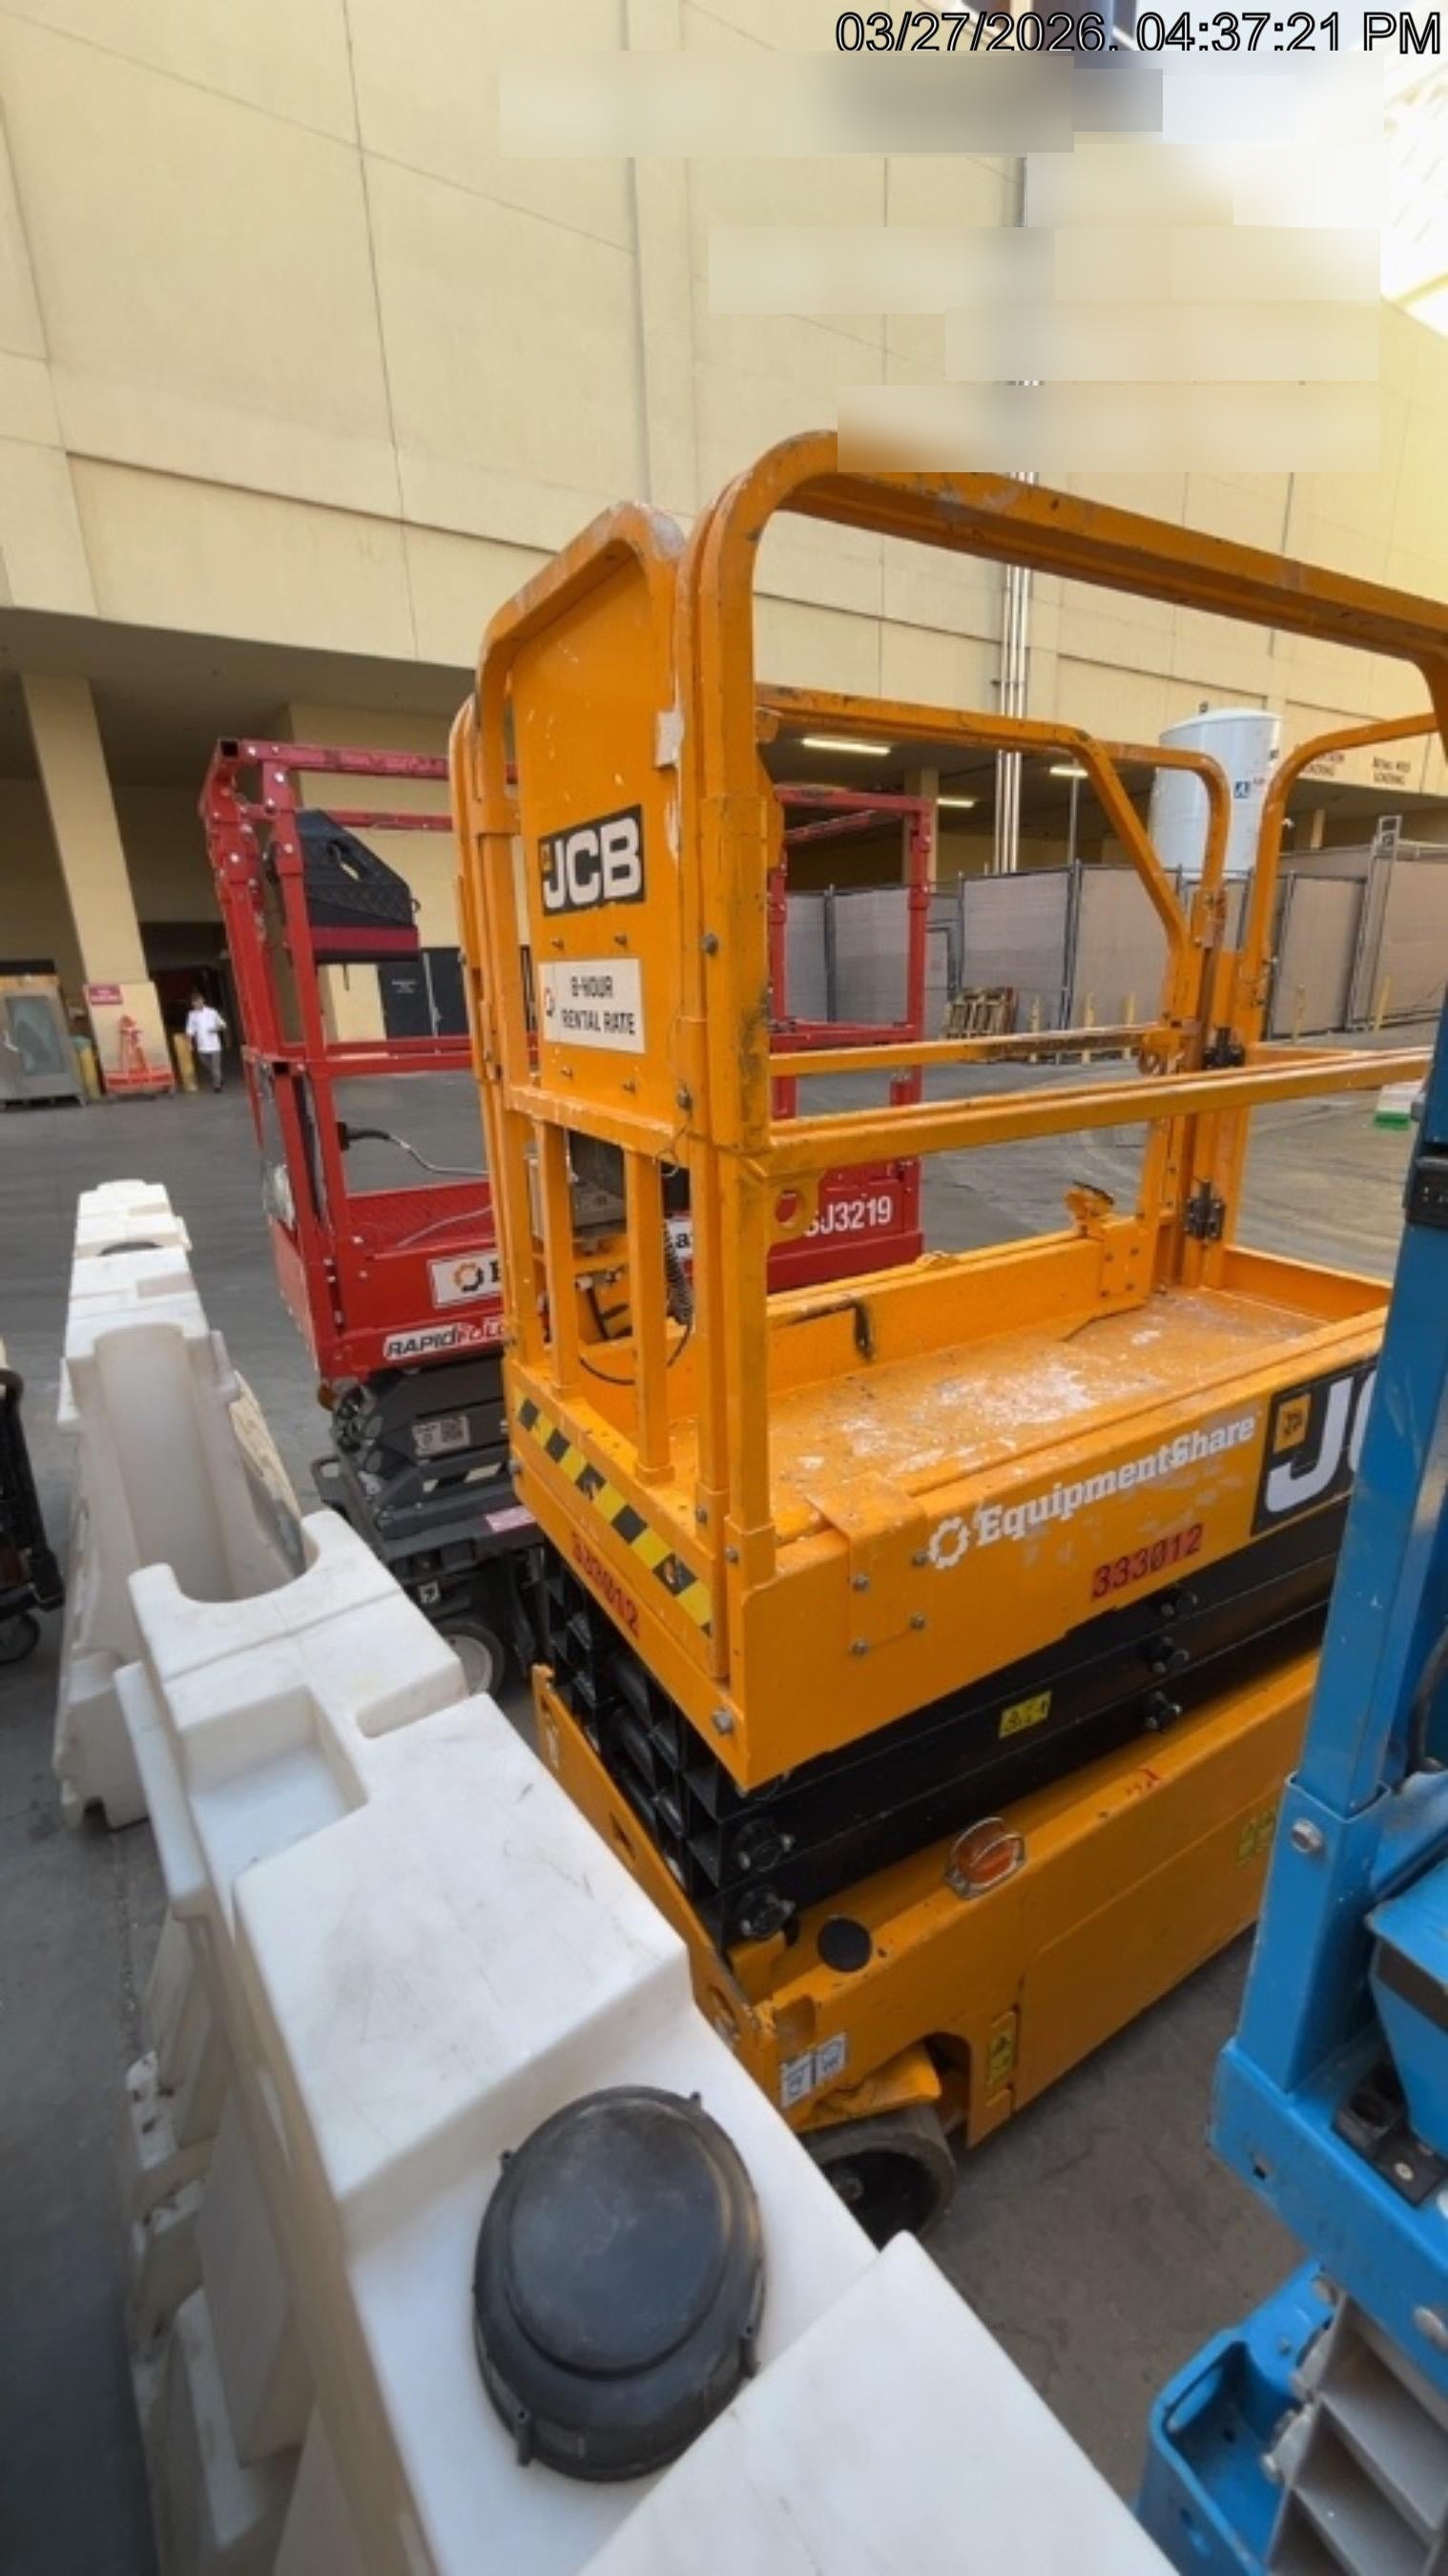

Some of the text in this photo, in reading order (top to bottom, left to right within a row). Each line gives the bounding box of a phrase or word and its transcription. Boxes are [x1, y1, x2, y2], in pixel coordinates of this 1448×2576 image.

[543, 818, 642, 909] JCB
[561, 1008, 635, 1035] RENTAL RATE
[571, 975, 612, 999] 8-HOUR
[977, 1416, 1255, 1547] EquipmentShare
[1091, 1523, 1204, 1600] 333012
